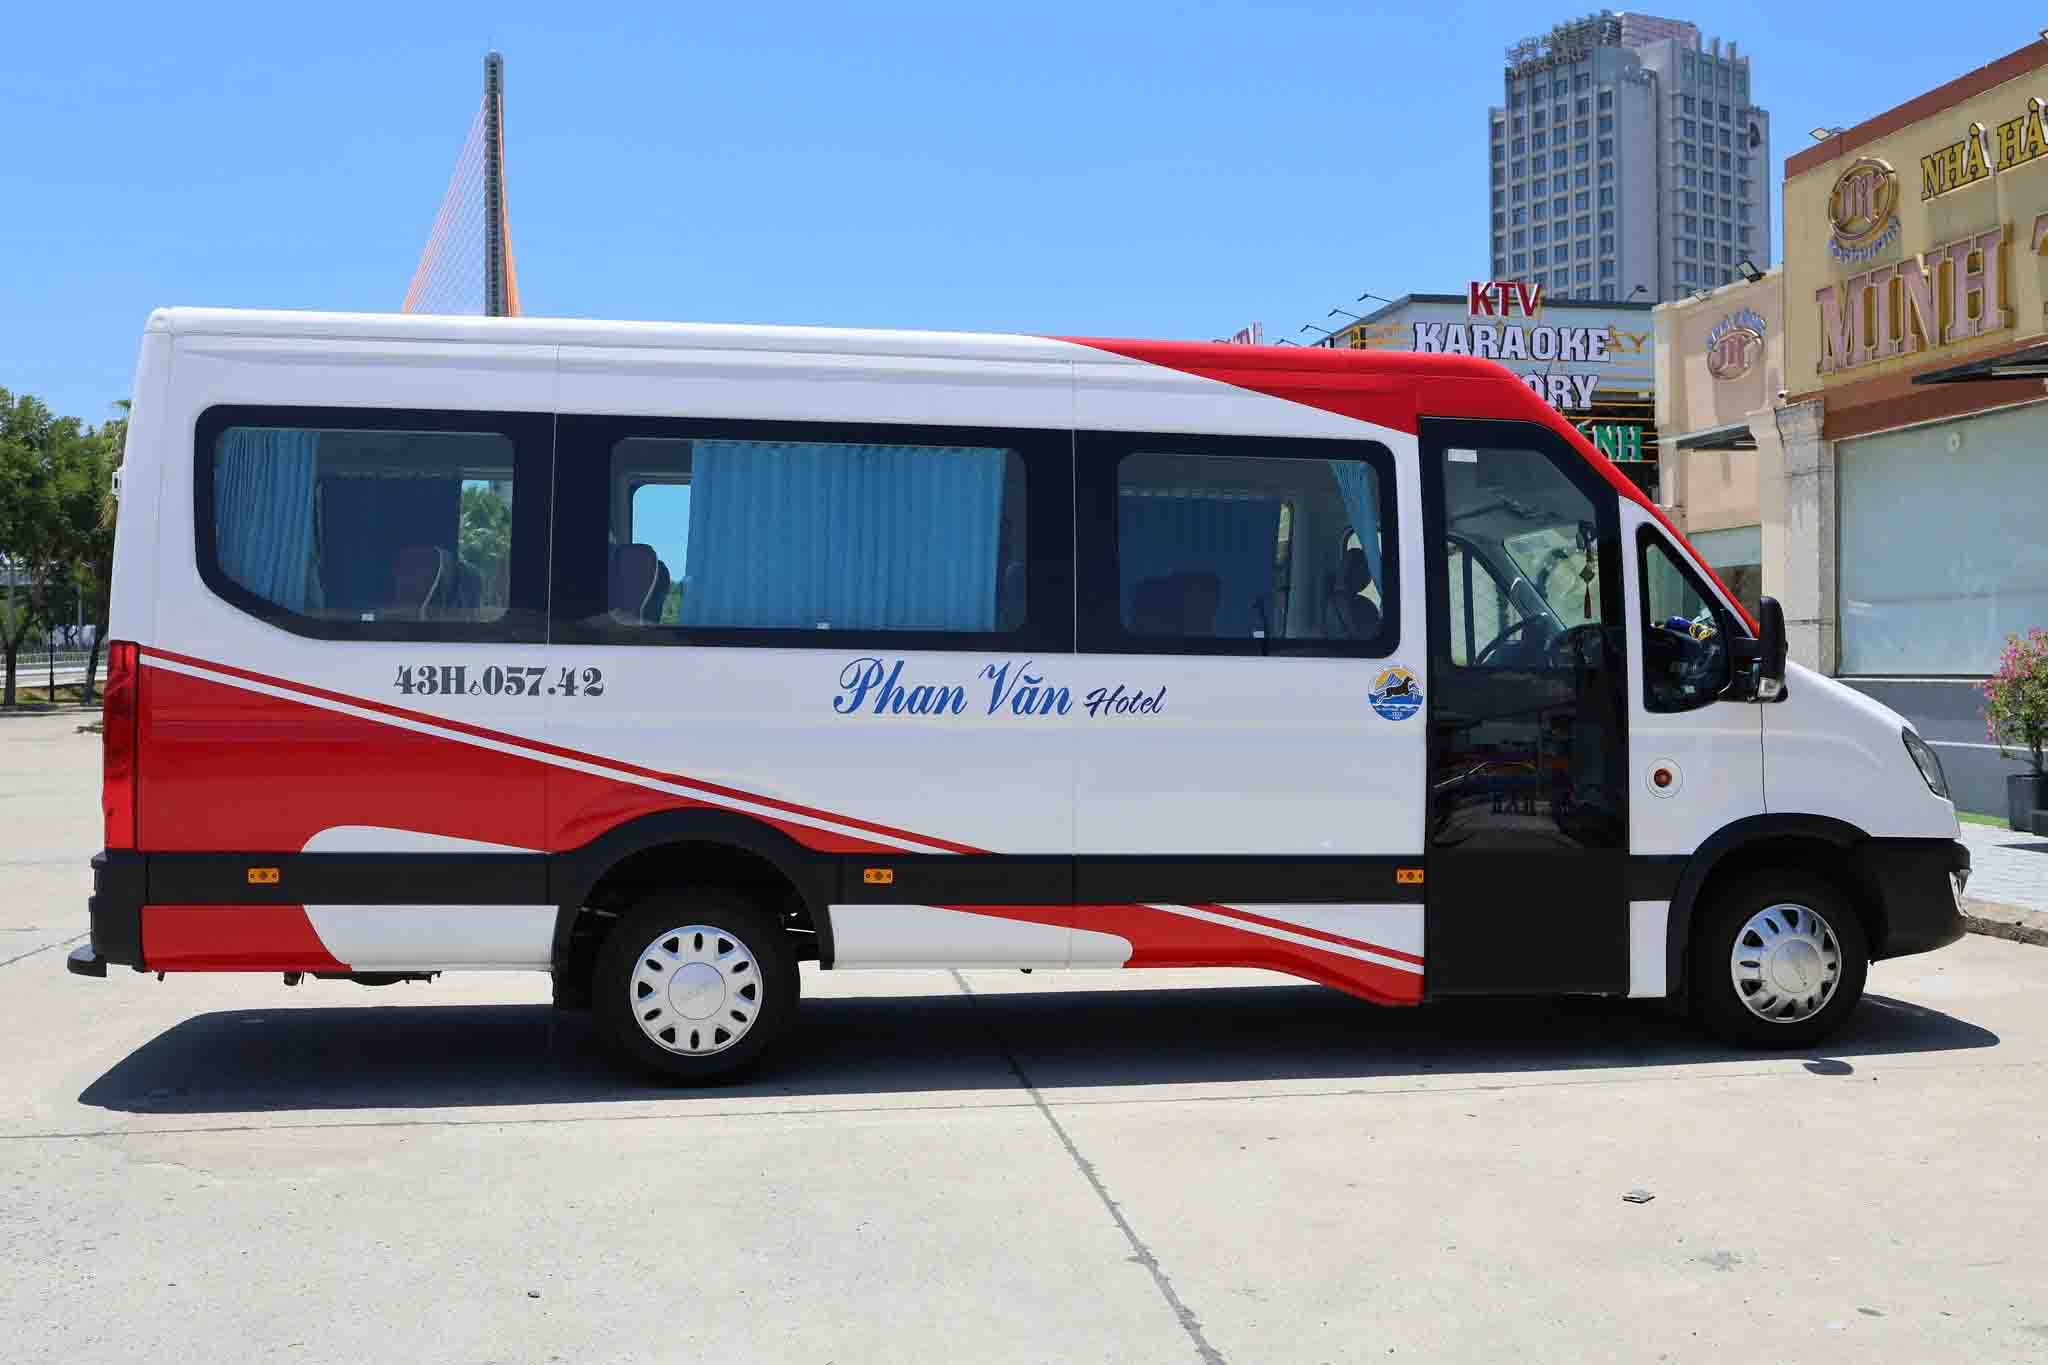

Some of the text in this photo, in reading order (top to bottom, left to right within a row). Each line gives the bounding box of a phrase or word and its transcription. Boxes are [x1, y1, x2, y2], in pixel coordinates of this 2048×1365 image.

[1469, 281, 1541, 317] KTV
[1815, 224, 2014, 377] MINH
[1412, 323, 1612, 362] KARAOKE
[1520, 373, 1599, 411] ORY
[833, 657, 1167, 718] Phan Văn Hotel
